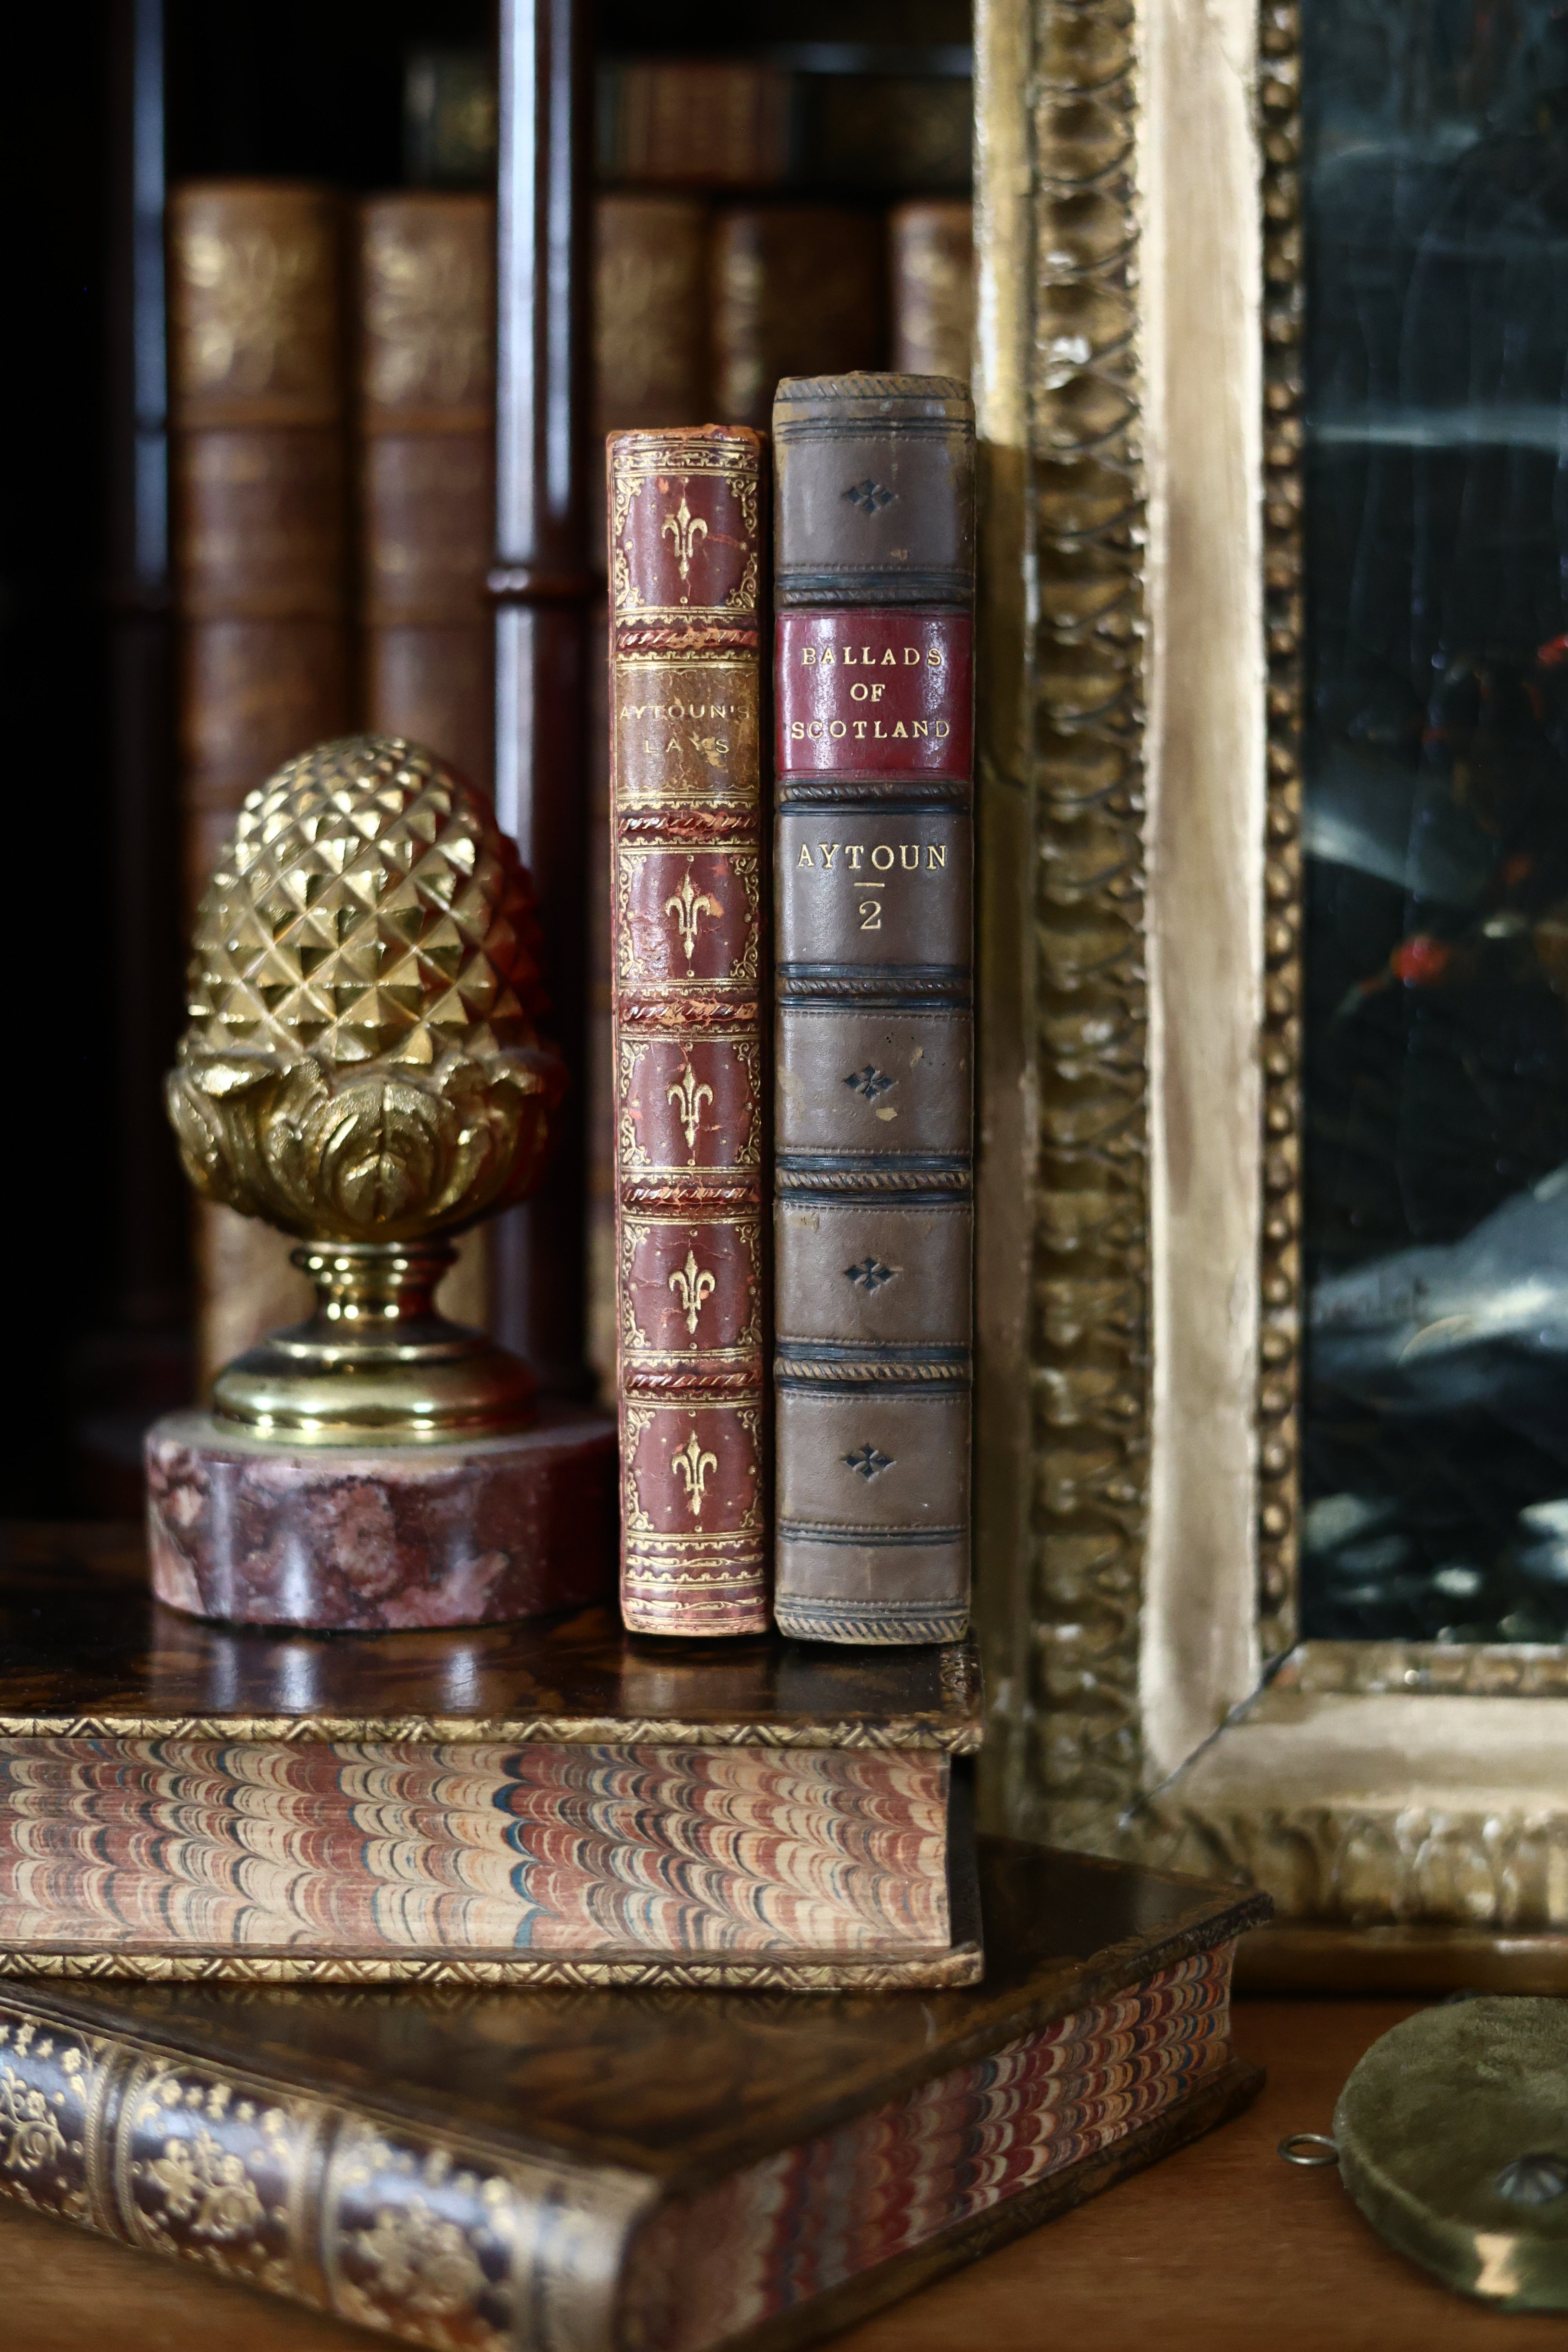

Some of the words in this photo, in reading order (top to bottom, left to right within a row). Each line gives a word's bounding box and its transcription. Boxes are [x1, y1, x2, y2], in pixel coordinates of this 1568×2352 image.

[802, 647, 942, 665] BALLADS
[850, 683, 885, 702] OF
[791, 721, 950, 739] SCOTLAND
[797, 844, 946, 870] AYTOUN
[859, 901, 882, 929] 2
